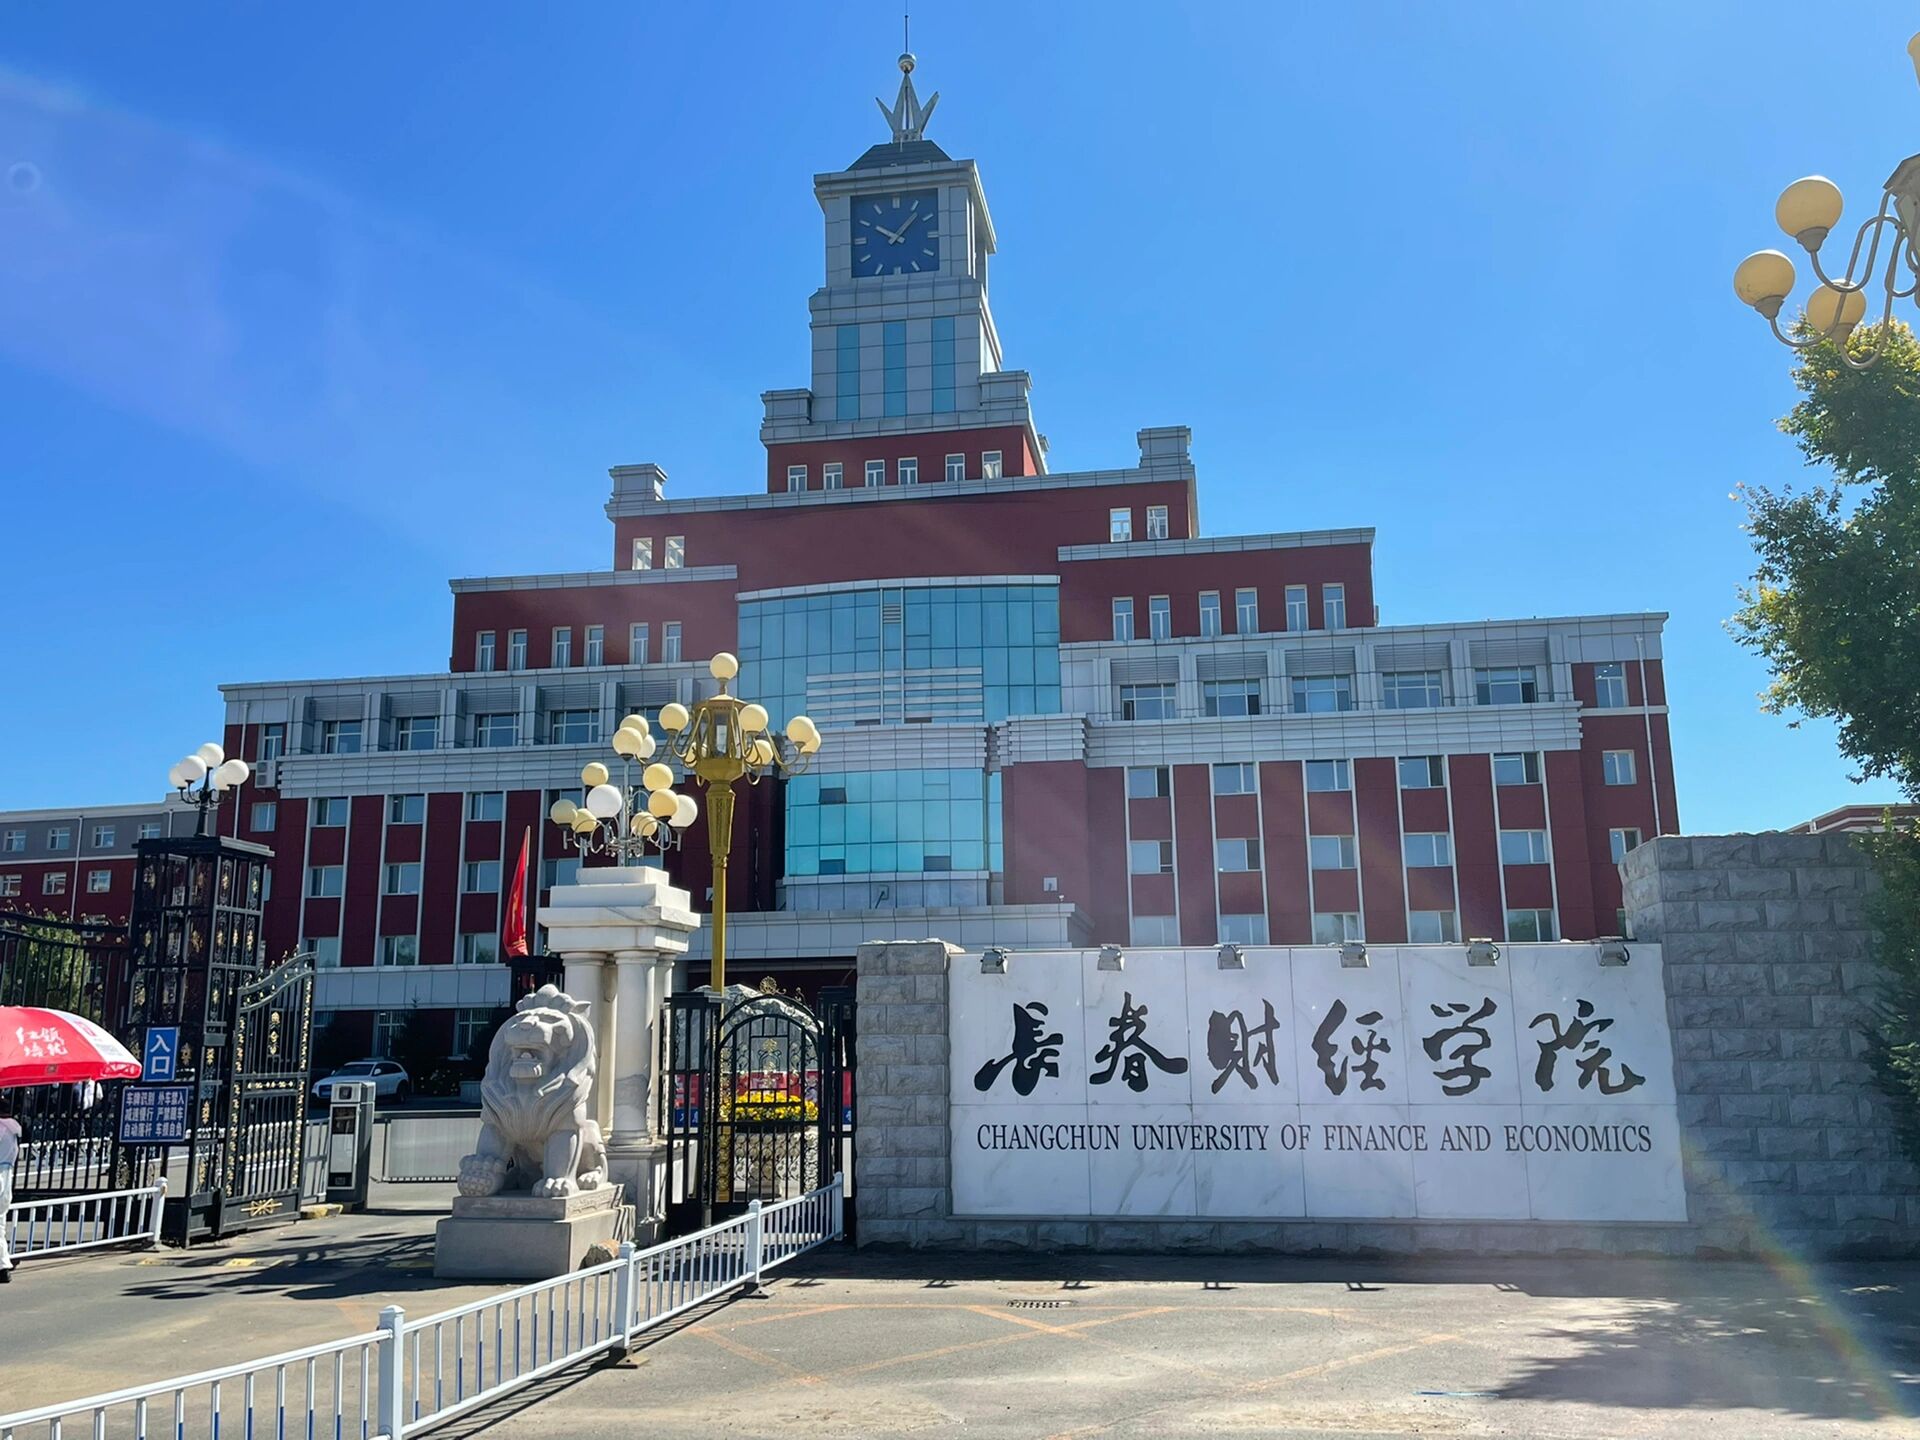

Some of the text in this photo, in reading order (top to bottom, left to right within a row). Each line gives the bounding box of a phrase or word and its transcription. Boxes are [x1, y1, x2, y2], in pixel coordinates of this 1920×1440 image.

[150, 1034, 171, 1074] 入口
[126, 1091, 155, 1106] 车牌识别
[124, 1106, 154, 1121] 减速慢行
[978, 1124, 1652, 1153] CHANGCHUN UNIVERSITY OF FINANCE AND ECONOMICS
